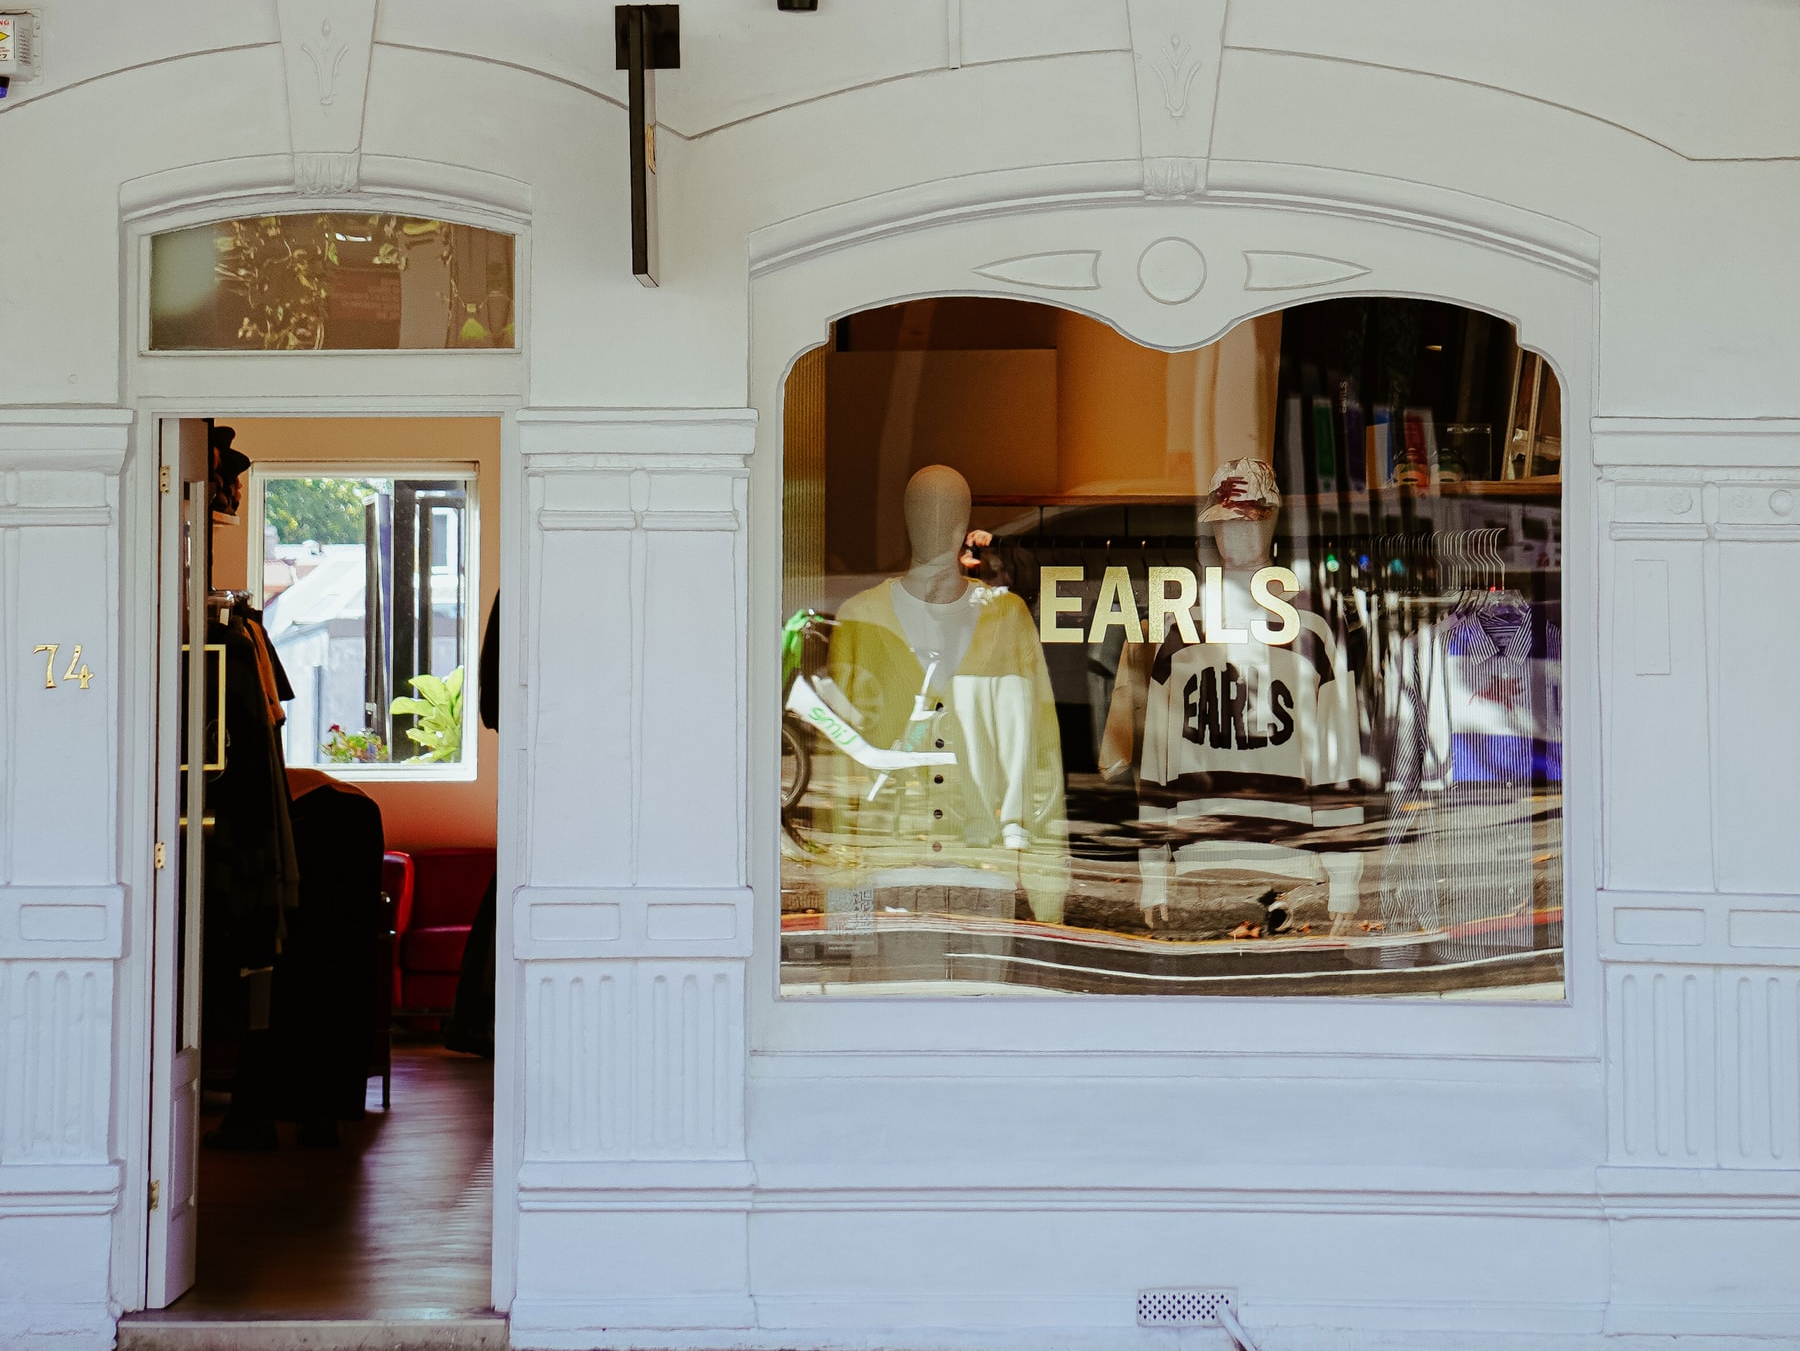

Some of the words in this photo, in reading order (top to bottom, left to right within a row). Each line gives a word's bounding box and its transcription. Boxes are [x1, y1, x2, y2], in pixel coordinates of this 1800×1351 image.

[1040, 565, 1301, 646] EARLS
[32, 643, 95, 690] 74
[1182, 661, 1295, 751] EARLS
